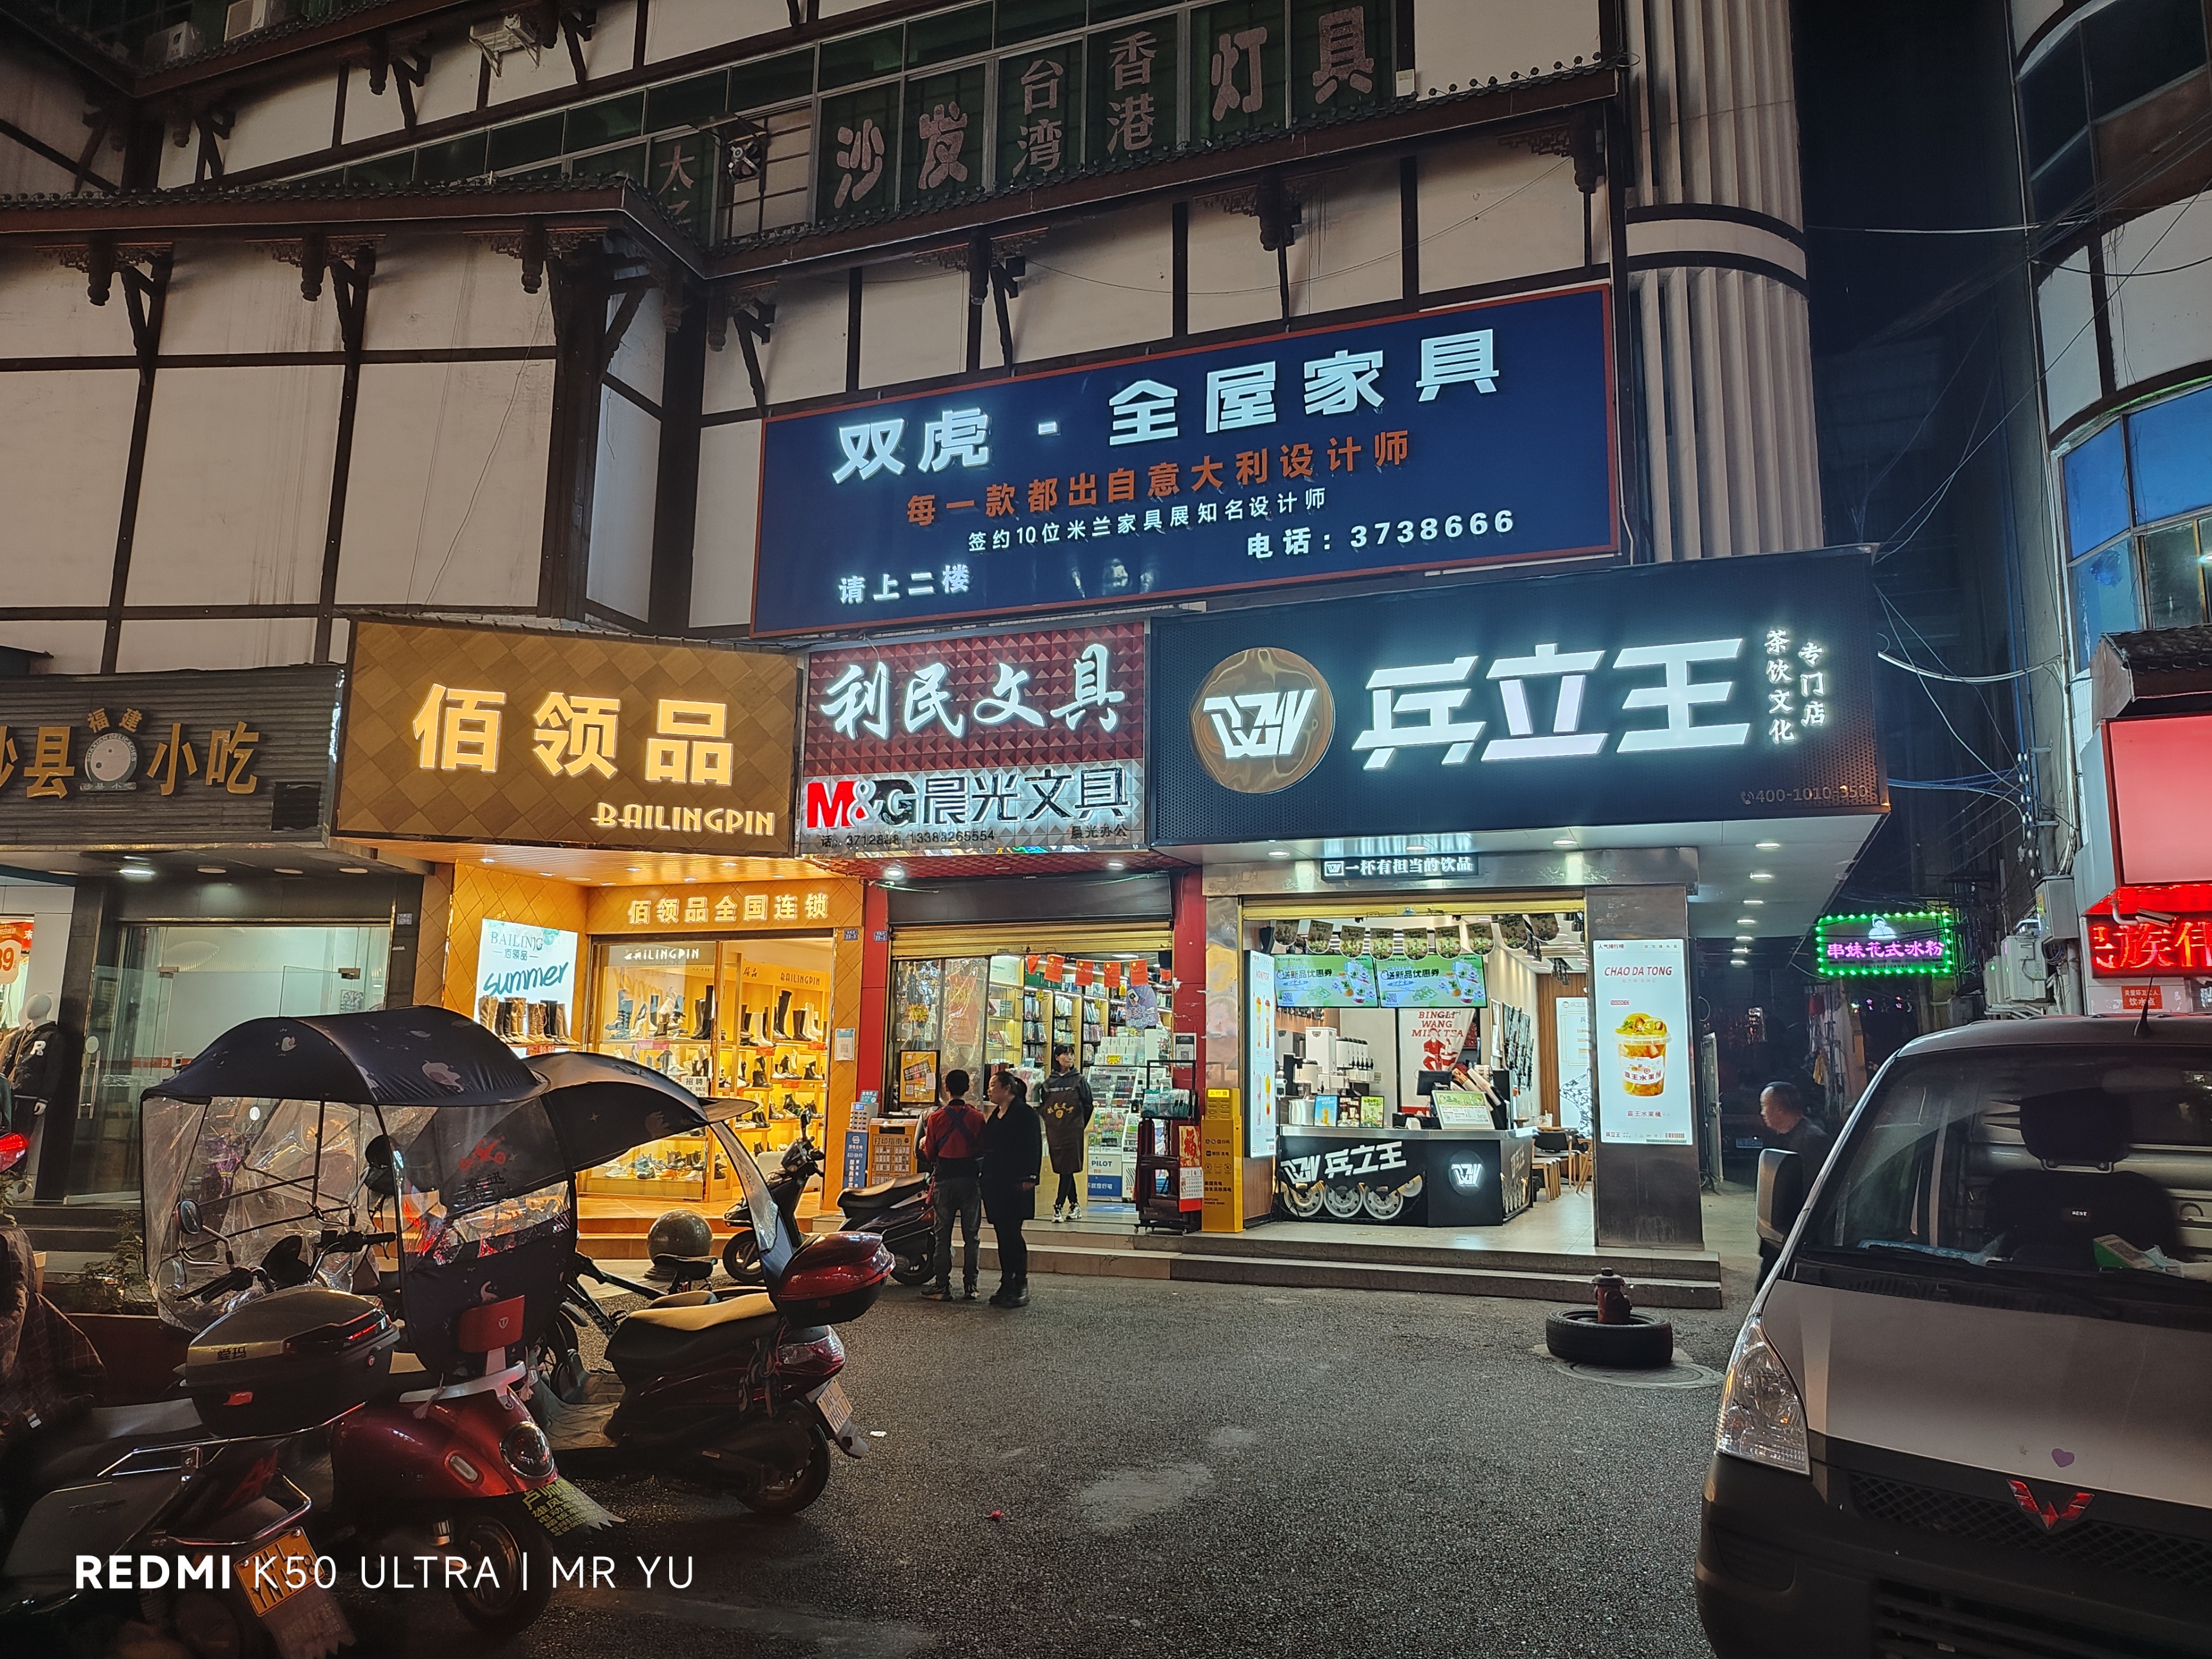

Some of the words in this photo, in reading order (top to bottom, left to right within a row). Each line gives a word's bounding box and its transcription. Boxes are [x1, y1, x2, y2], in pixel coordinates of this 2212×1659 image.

[1212, 5, 1375, 122] 灯具
[1106, 31, 1158, 154] 香港
[1012, 59, 1064, 178] 台湾
[834, 101, 968, 208] 沙发
[832, 407, 990, 485] 双虎
[1109, 328, 1500, 446] 全屋家具
[907, 430, 1409, 527] 每一款都出自意大利设计师
[968, 488, 1326, 552] 签约10位米兰家具展知名设计师
[839, 564, 970, 605] 请上二楼
[820, 643, 1125, 740] 利民文具
[1351, 637, 1751, 770] 兵立王
[1764, 630, 1797, 744] 茶饮文化
[1798, 642, 1826, 728] 专门店
[87, 708, 143, 733] 福建
[413, 683, 734, 786] 佰领品
[87, 735, 109, 762] SHAXIAN
[109, 734, 137, 762] DELICACIES
[147, 721, 260, 796] 小吃
[922, 767, 1131, 825] 晨光文具
[1755, 785, 1869, 803] 400-1010-350
[592, 802, 775, 836] BAILINGPIN
[1345, 856, 1474, 876] 一杯有担当的饮品
[628, 893, 829, 924] 佰领品全国连锁
[505, 948, 528, 961] 佰领品
[1827, 940, 1945, 959] 串妹花式冰粉
[483, 961, 569, 997] summer
[780, 972, 821, 986] BAILINGPIN
[1283, 968, 1333, 980] 送新品优惠券
[1387, 968, 1439, 980] 送新品优惠券
[1604, 966, 1630, 976] CHAO
[1632, 966, 1644, 976] DA
[1646, 966, 1672, 976] TONG
[30, 1040, 46, 1057] R
[1324, 1140, 1407, 1179] 兵立王
